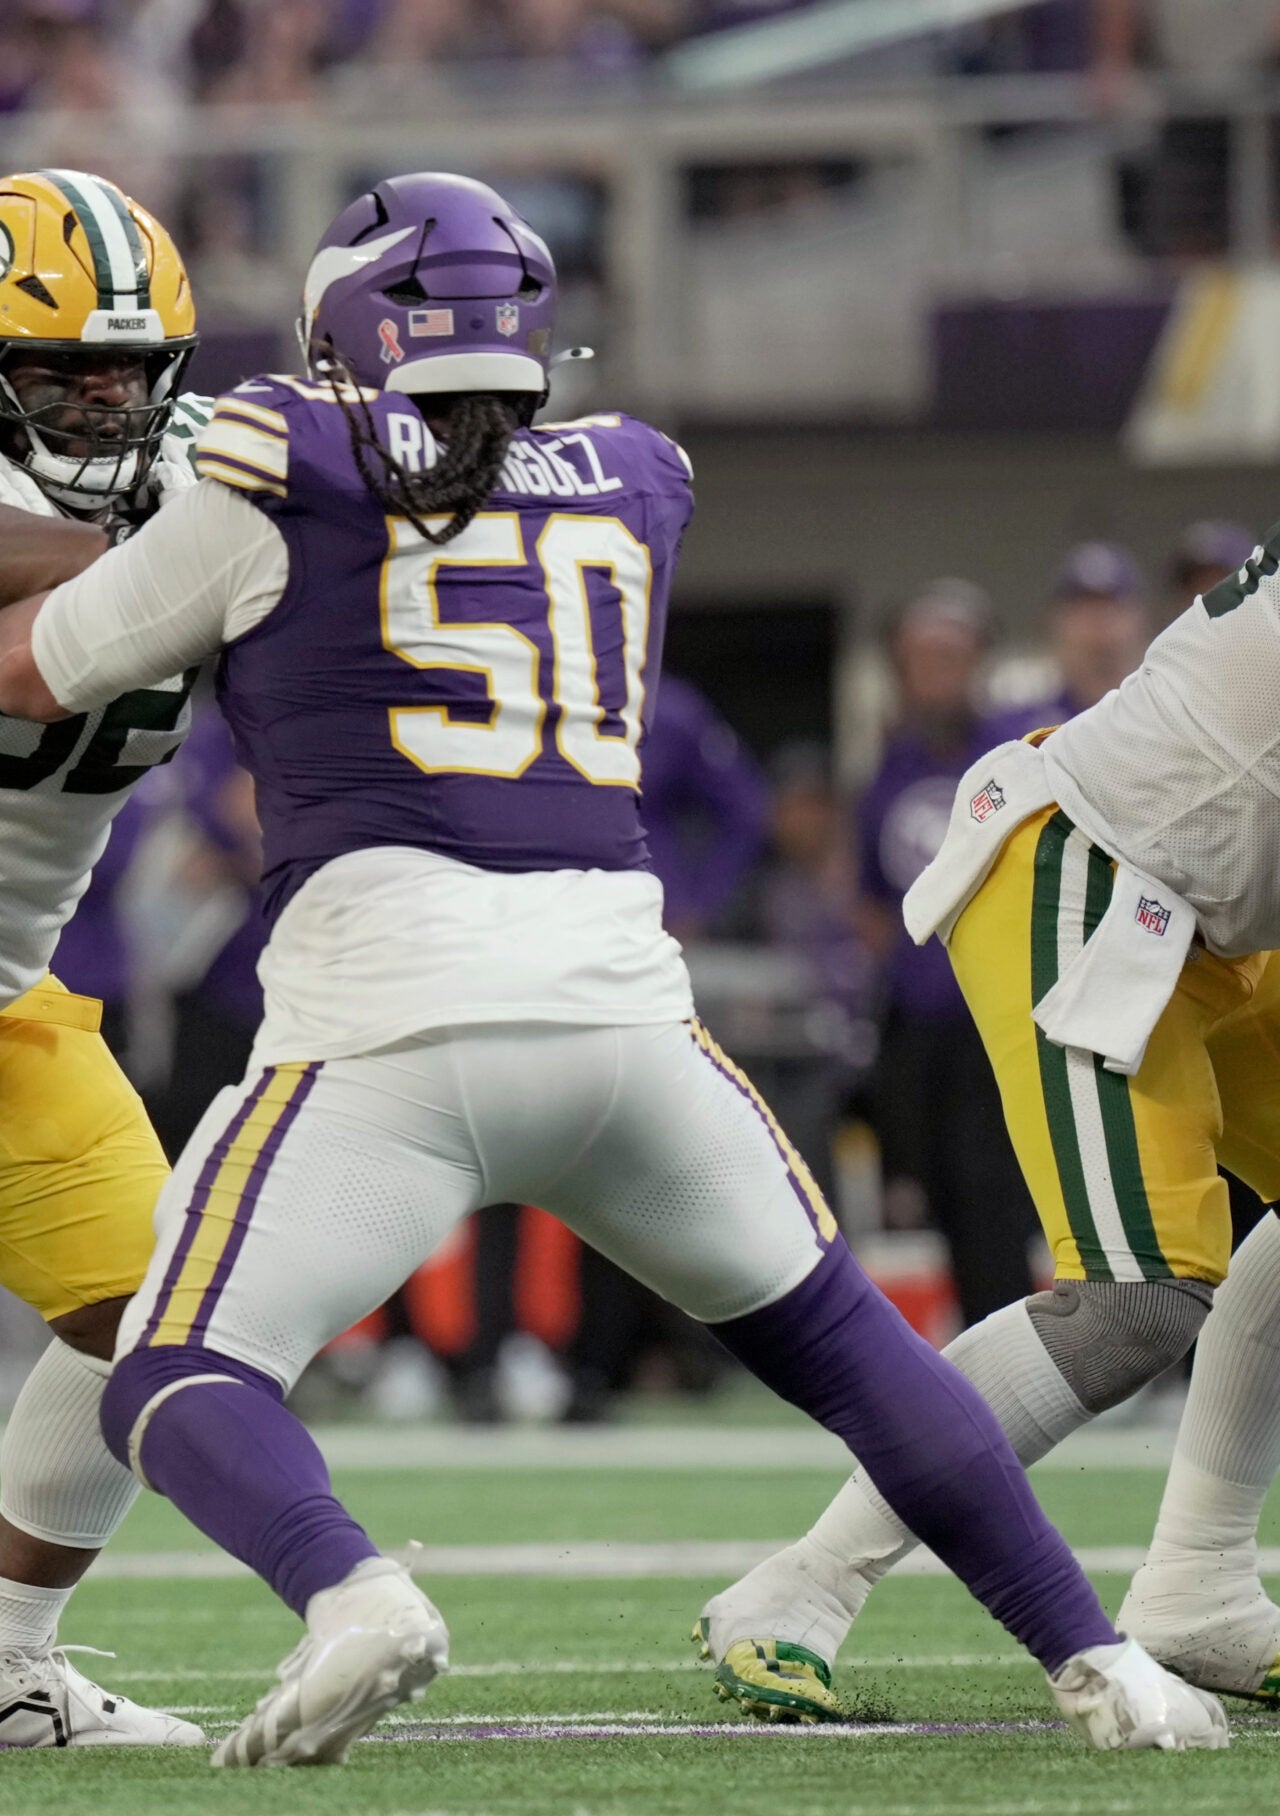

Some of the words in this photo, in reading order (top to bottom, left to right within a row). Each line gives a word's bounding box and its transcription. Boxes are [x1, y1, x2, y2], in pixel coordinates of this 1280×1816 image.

[107, 317, 147, 331] PACKERS
[379, 511, 653, 795] 50
[972, 791, 994, 821] NFL
[1137, 909, 1163, 934] NFL
